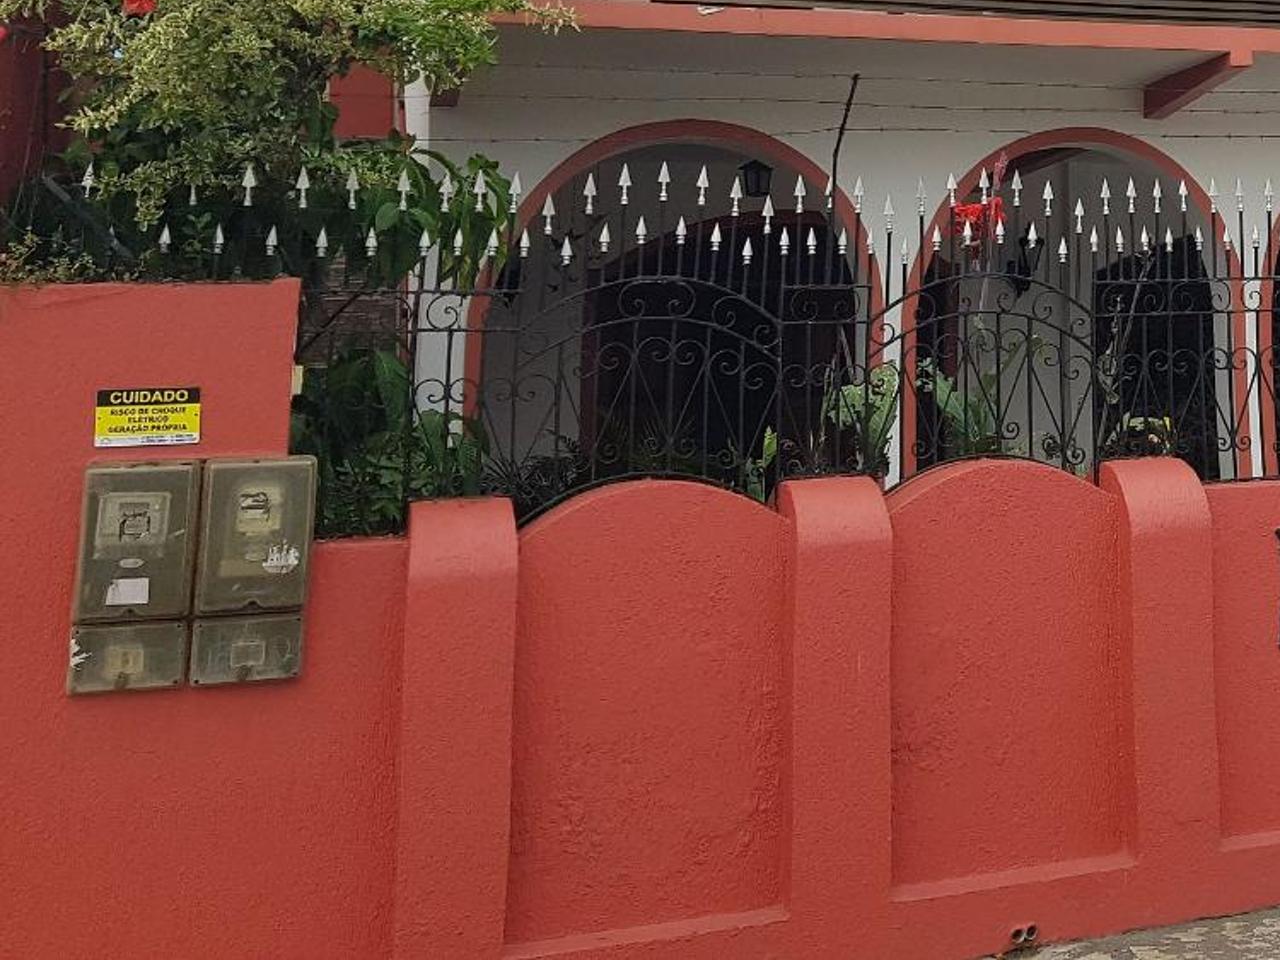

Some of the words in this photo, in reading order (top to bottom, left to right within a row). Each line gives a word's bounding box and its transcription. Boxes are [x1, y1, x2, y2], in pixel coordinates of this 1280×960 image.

[110, 390, 189, 404] CUIDADO
[110, 408, 136, 416] RISCO
[151, 406, 187, 414] CHOQUE
